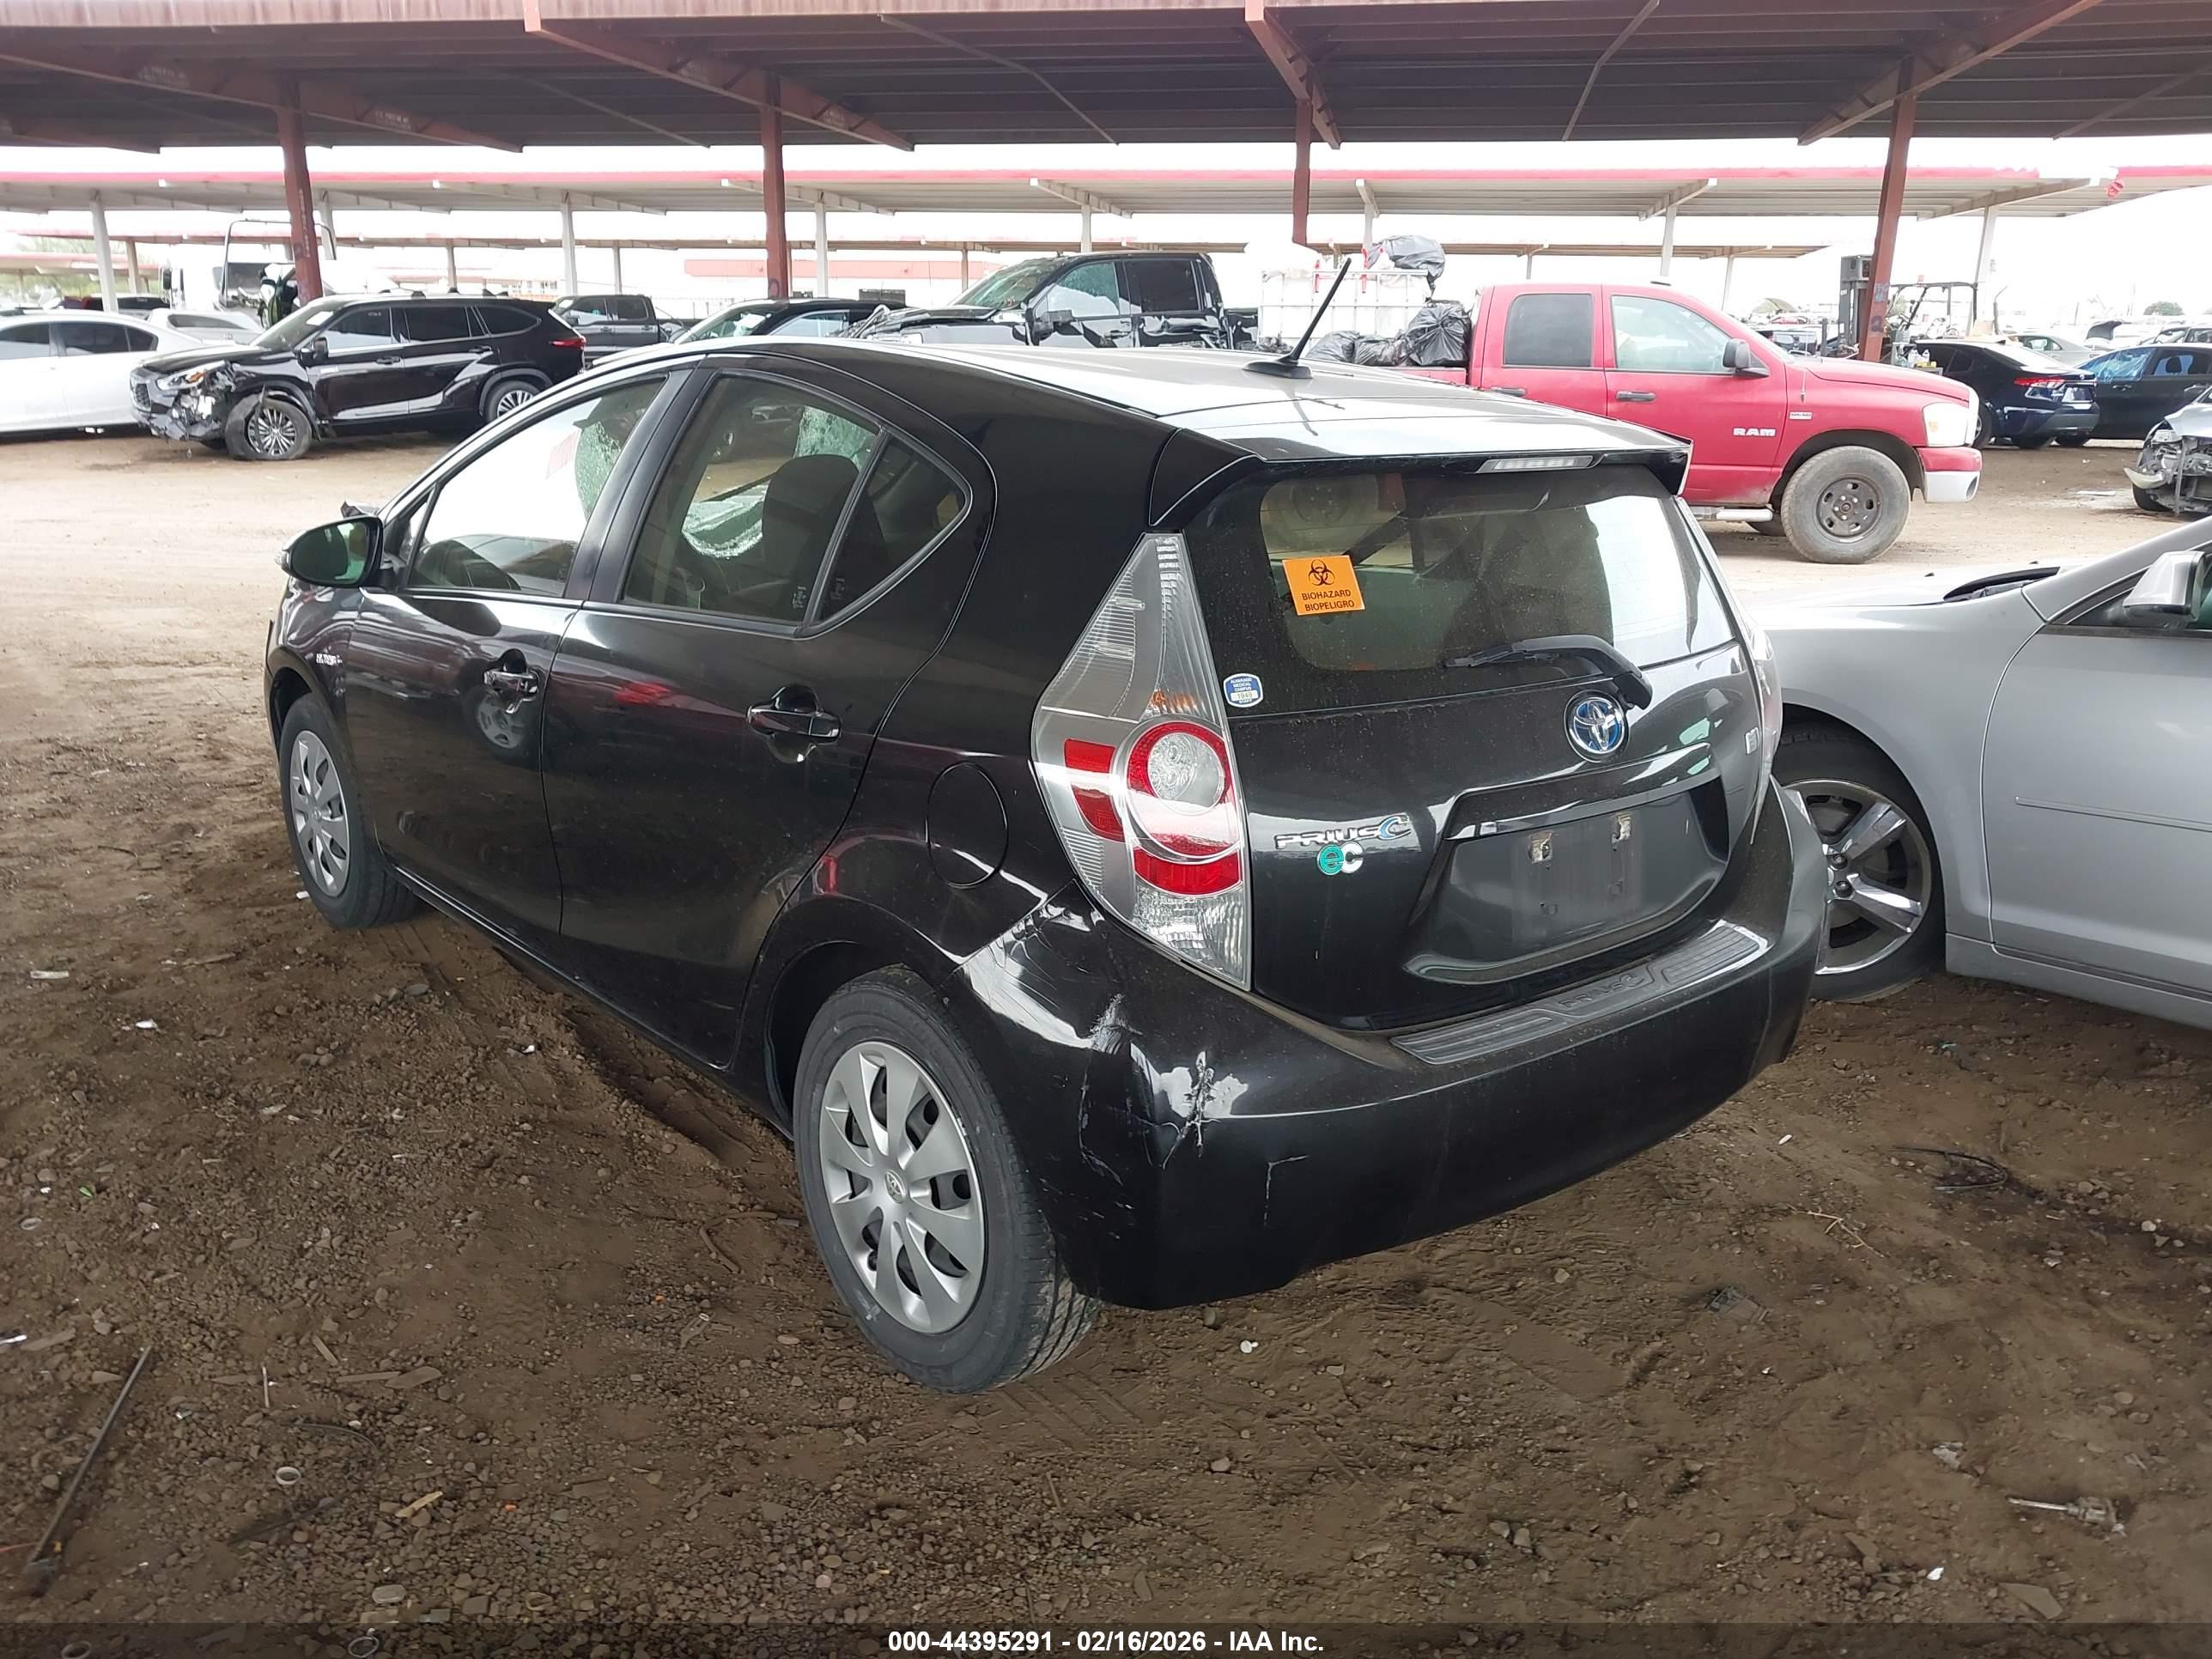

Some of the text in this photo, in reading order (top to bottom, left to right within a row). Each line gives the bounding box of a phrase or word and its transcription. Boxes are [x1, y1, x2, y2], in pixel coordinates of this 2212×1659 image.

[1733, 428, 1776, 436] RAM
[1302, 589, 1352, 601] BIOHAZARD
[1304, 599, 1355, 611] BIOPELIGRO
